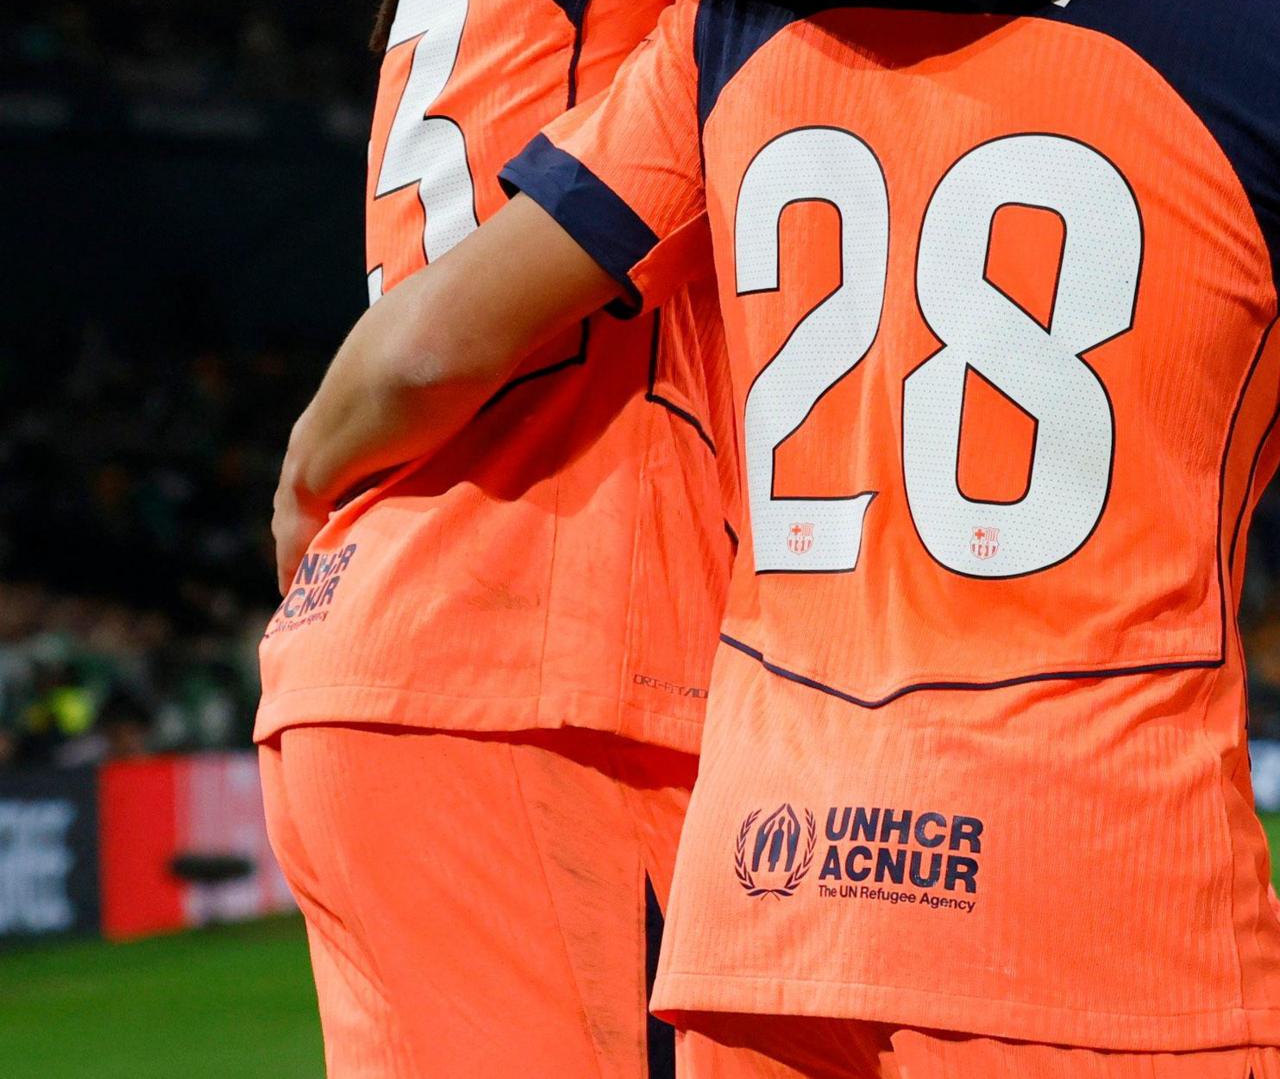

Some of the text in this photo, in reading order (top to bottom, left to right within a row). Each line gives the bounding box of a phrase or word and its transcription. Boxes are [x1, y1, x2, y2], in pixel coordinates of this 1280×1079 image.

[734, 125, 1145, 580] 28
[825, 807, 984, 854] UNHCR
[818, 845, 979, 894] ACNUR
[818, 885, 976, 913] The UN Refugee Agency
